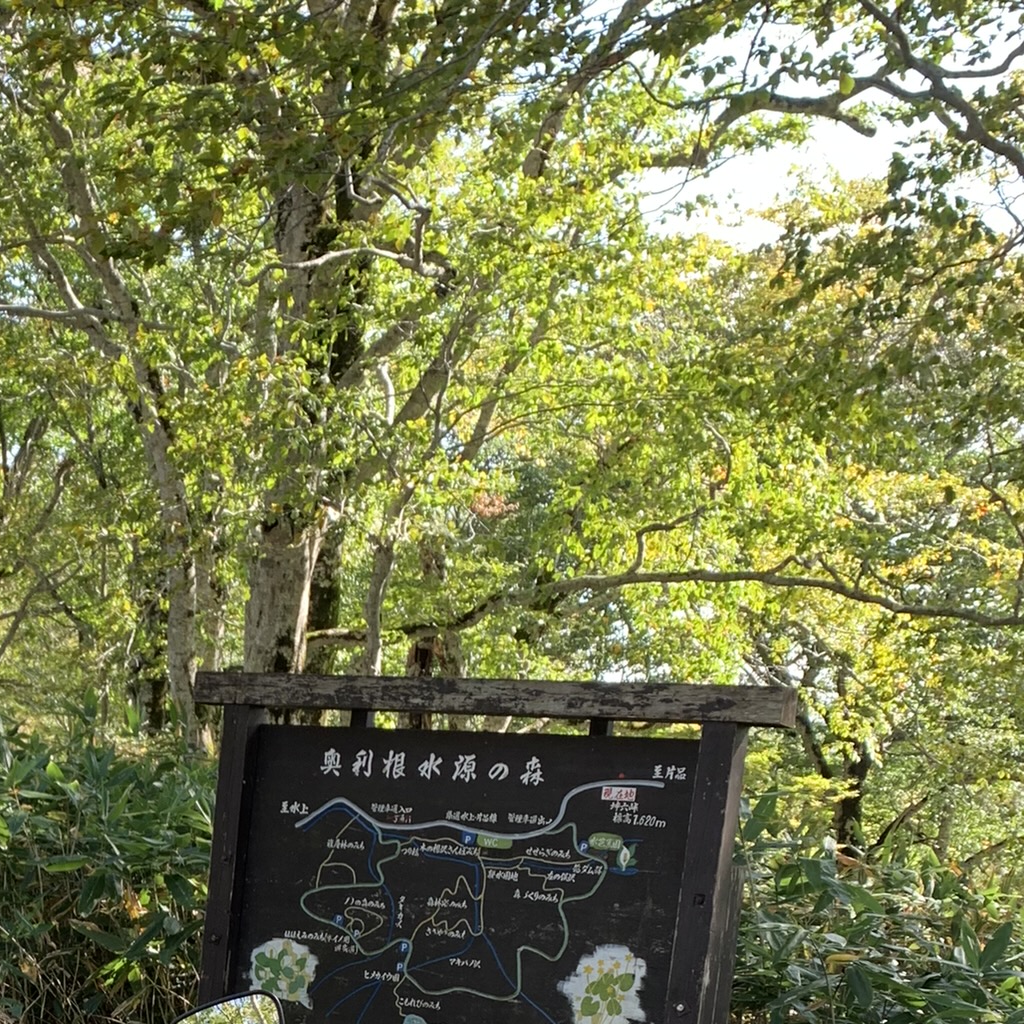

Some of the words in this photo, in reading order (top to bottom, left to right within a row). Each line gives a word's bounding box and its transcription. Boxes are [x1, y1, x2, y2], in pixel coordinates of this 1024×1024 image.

[320, 747, 544, 787] 奥利根水源の森
[651, 764, 687, 780] 至片品
[279, 800, 310, 815] 至水上
[483, 838, 499, 847] WC
